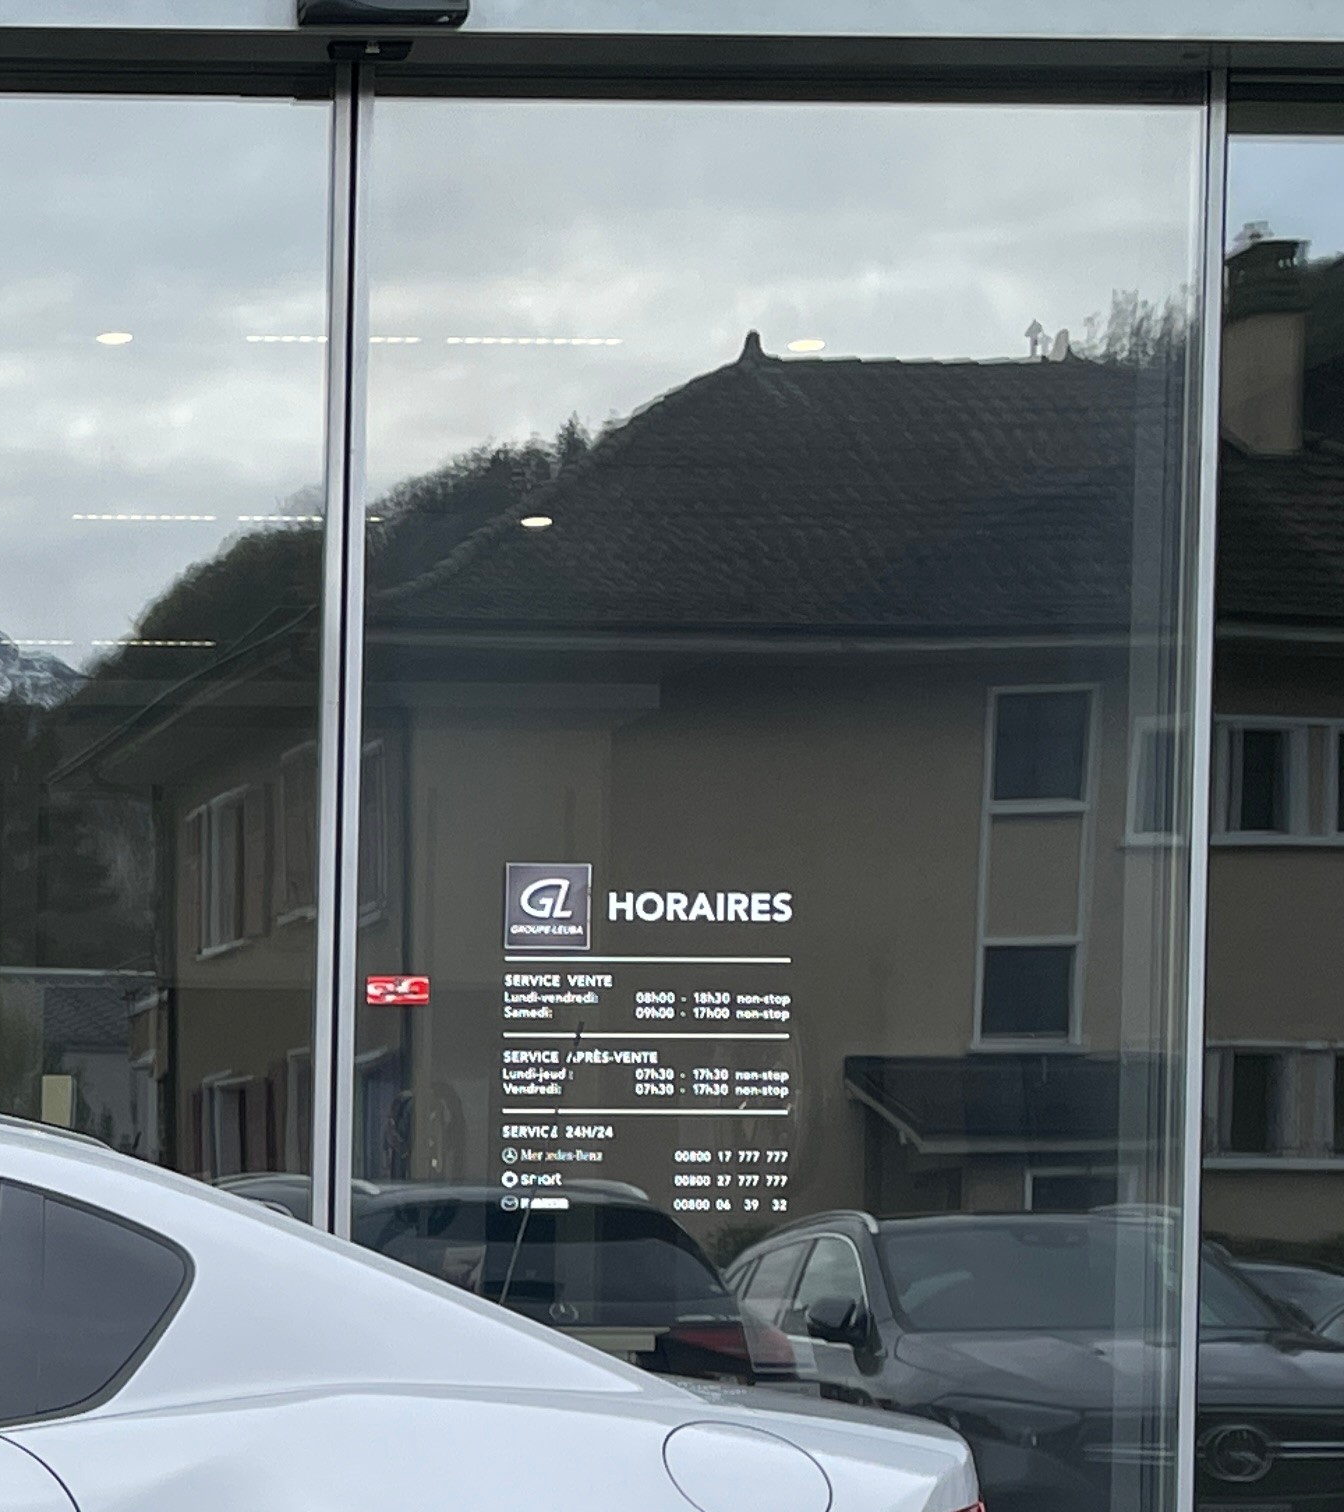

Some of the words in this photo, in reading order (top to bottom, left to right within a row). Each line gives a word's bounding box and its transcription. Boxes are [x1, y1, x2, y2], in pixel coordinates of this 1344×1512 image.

[608, 891, 794, 923] HORAIRES
[511, 924, 551, 935] GROUPE
[552, 925, 584, 936] LEUBA
[504, 974, 561, 987] SERVICE
[567, 974, 613, 987] VENTE
[635, 991, 676, 1004] 08h00
[693, 991, 731, 1004] 18h30
[736, 994, 791, 1007] non-stop
[635, 1006, 675, 1019] 09h00
[693, 1006, 730, 1019] 17h00
[735, 1009, 790, 1022] non-stop
[502, 1050, 560, 1063] SERVICE
[566, 1049, 658, 1064] APRÈS-VENTE
[635, 1067, 675, 1080] 07h30
[692, 1067, 729, 1080] 17h30
[735, 1070, 790, 1083] non-stop
[635, 1083, 675, 1096] 07h30
[692, 1083, 729, 1096] 17h30
[735, 1085, 789, 1099] non-stop
[565, 1125, 614, 1138] 24H/24
[520, 1149, 603, 1162] Meredes-Benz
[674, 1150, 712, 1162] 00800
[717, 1151, 732, 1162] 17
[738, 1150, 760, 1163] 777
[766, 1150, 789, 1163] 777
[716, 1174, 732, 1187] 27
[737, 1175, 760, 1187] 777
[765, 1175, 789, 1187] 777
[715, 1198, 732, 1211] 06
[743, 1198, 760, 1211] 39
[772, 1198, 788, 1211] 32
